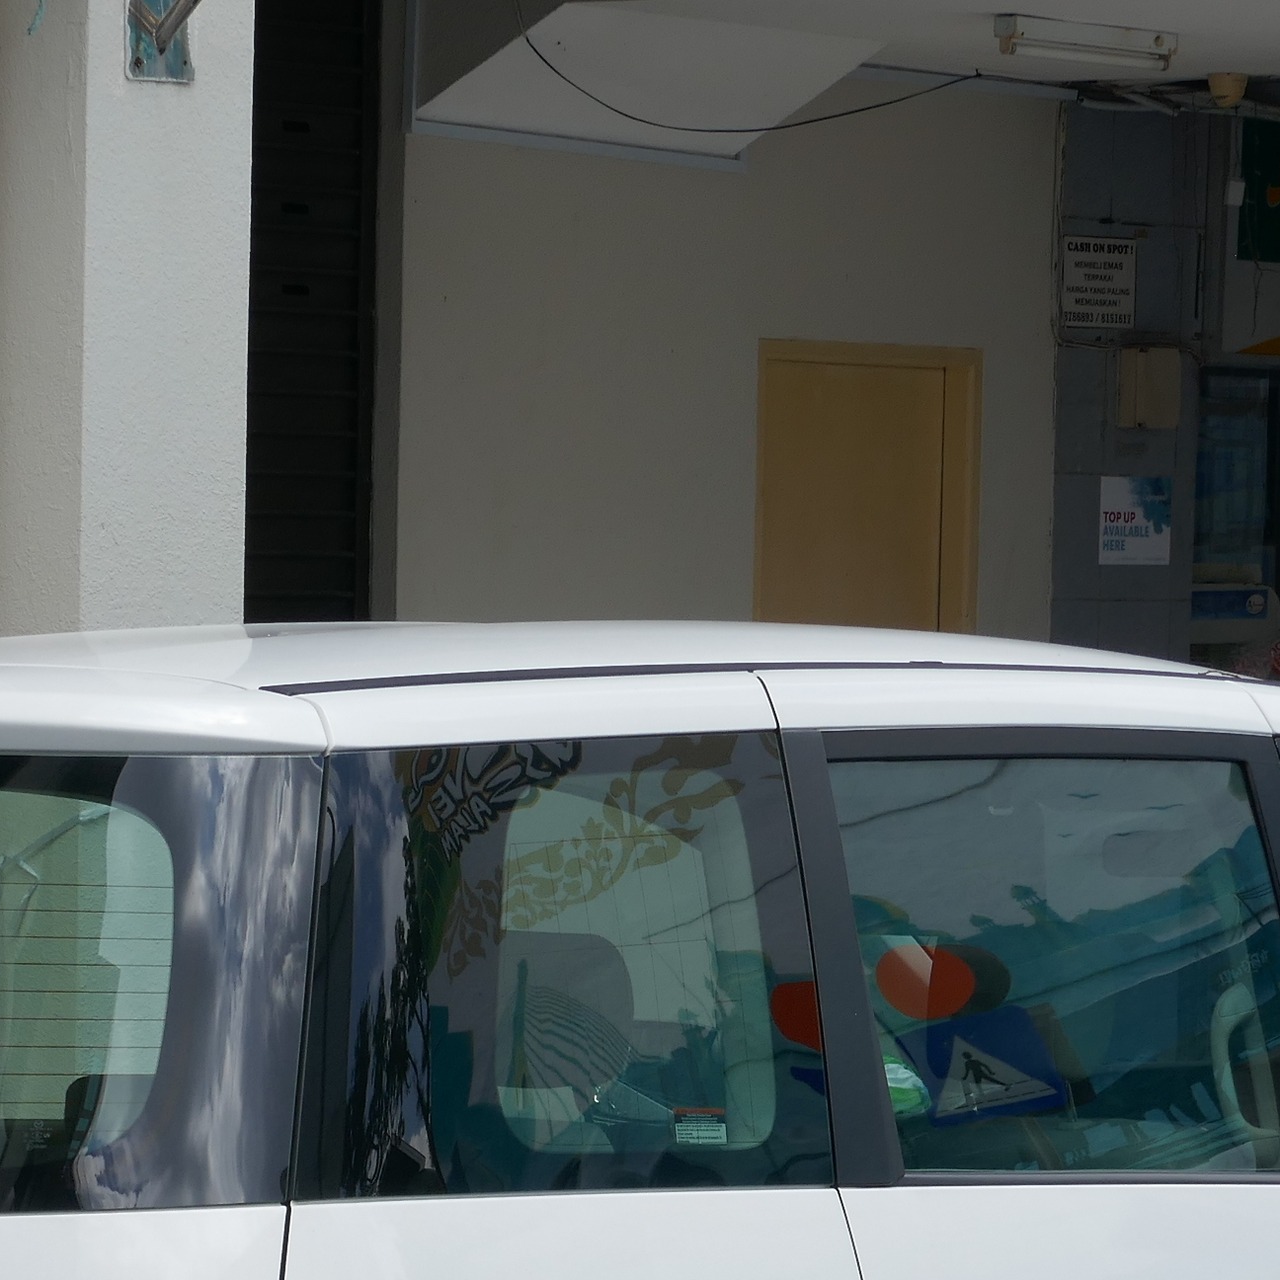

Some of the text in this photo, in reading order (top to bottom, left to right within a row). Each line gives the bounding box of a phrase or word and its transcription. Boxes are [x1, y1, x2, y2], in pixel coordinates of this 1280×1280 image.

[1068, 242, 1091, 253] CASH
[1093, 243, 1105, 254] ON
[1103, 262, 1123, 270] EMAS
[1103, 511, 1136, 523] TOP UP
[1103, 525, 1149, 537] AVAILABLE
[1103, 540, 1125, 551] HERE
